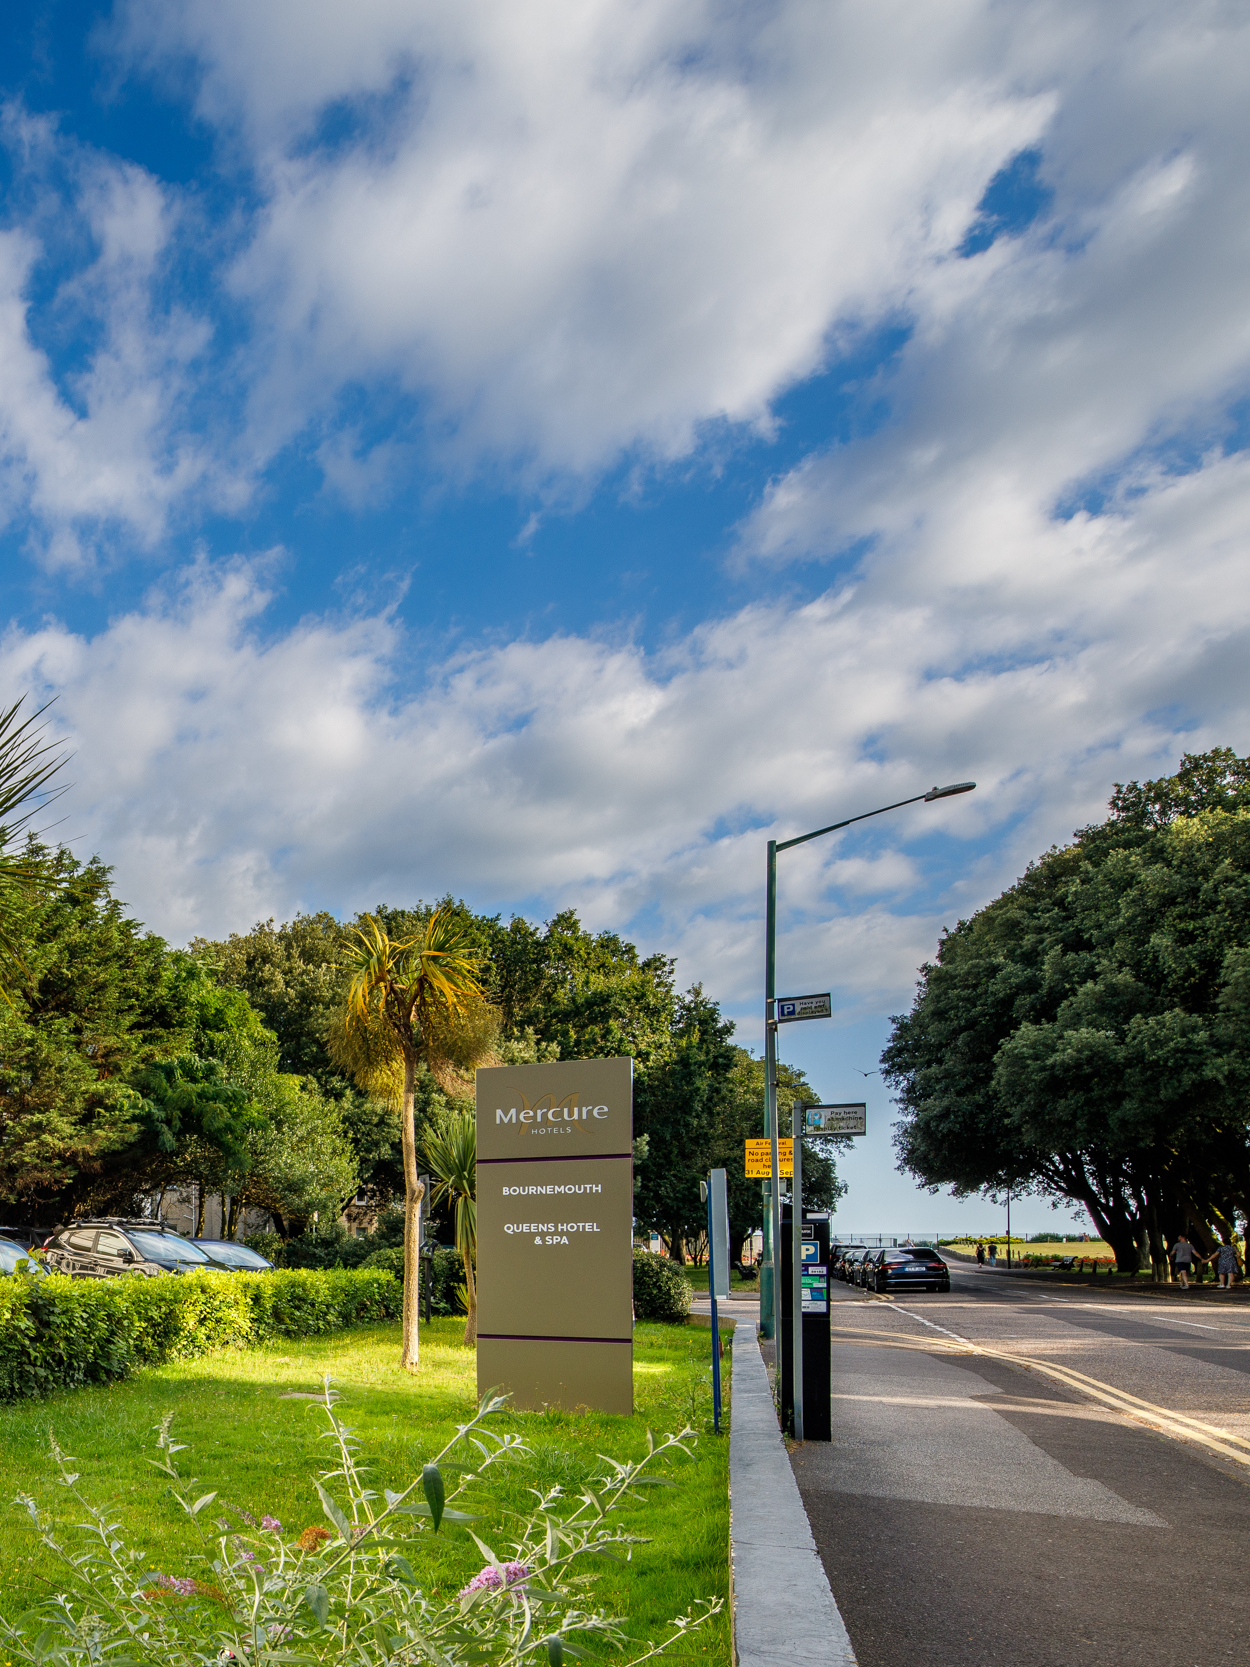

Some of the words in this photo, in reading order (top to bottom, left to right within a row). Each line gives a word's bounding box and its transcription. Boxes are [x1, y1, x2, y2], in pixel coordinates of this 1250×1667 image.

[495, 1104, 608, 1124] Mercure
[531, 1126, 572, 1134] HOTELS
[502, 1184, 602, 1196] BOURNEMOUTH
[504, 1224, 555, 1233] QUEENS
[558, 1222, 600, 1232] HOTEL
[534, 1236, 543, 1245] &
[545, 1236, 569, 1245] SPA
